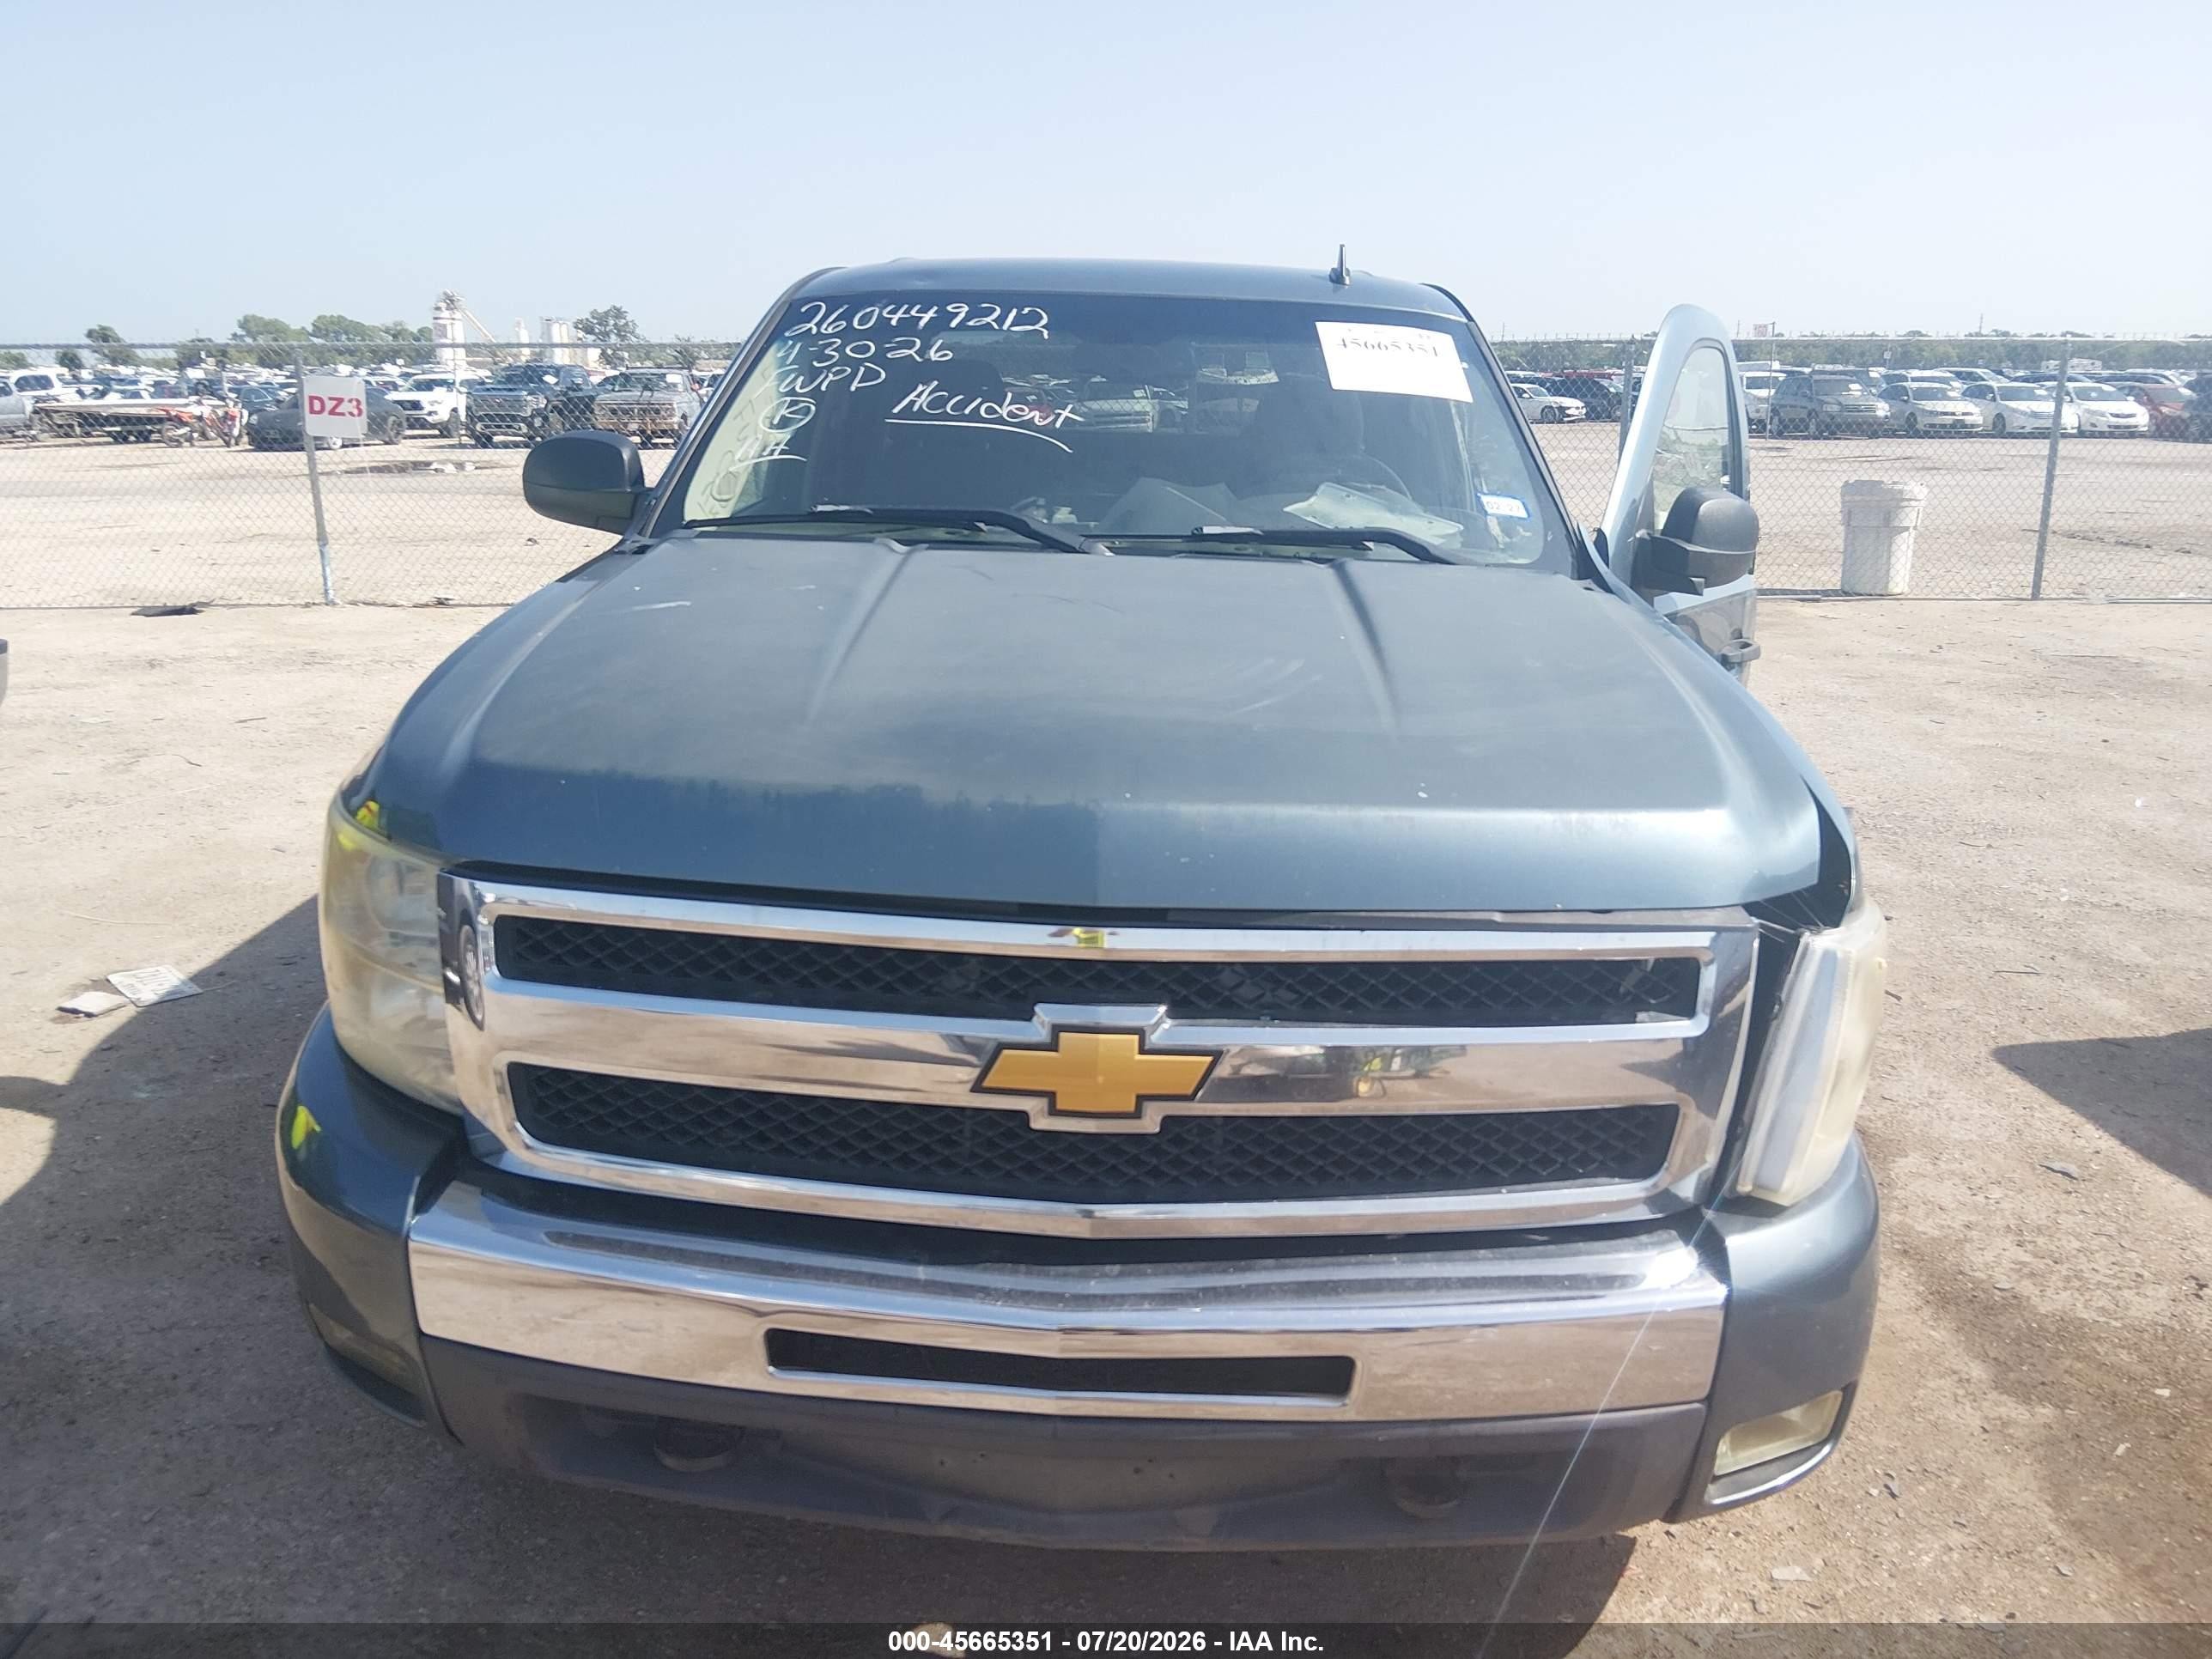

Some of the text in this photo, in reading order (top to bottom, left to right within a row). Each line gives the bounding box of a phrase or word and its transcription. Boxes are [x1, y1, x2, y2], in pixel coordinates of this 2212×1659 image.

[784, 301, 1049, 340] 260449212
[308, 395, 363, 417] DZ3
[892, 380, 1084, 428] Accident
